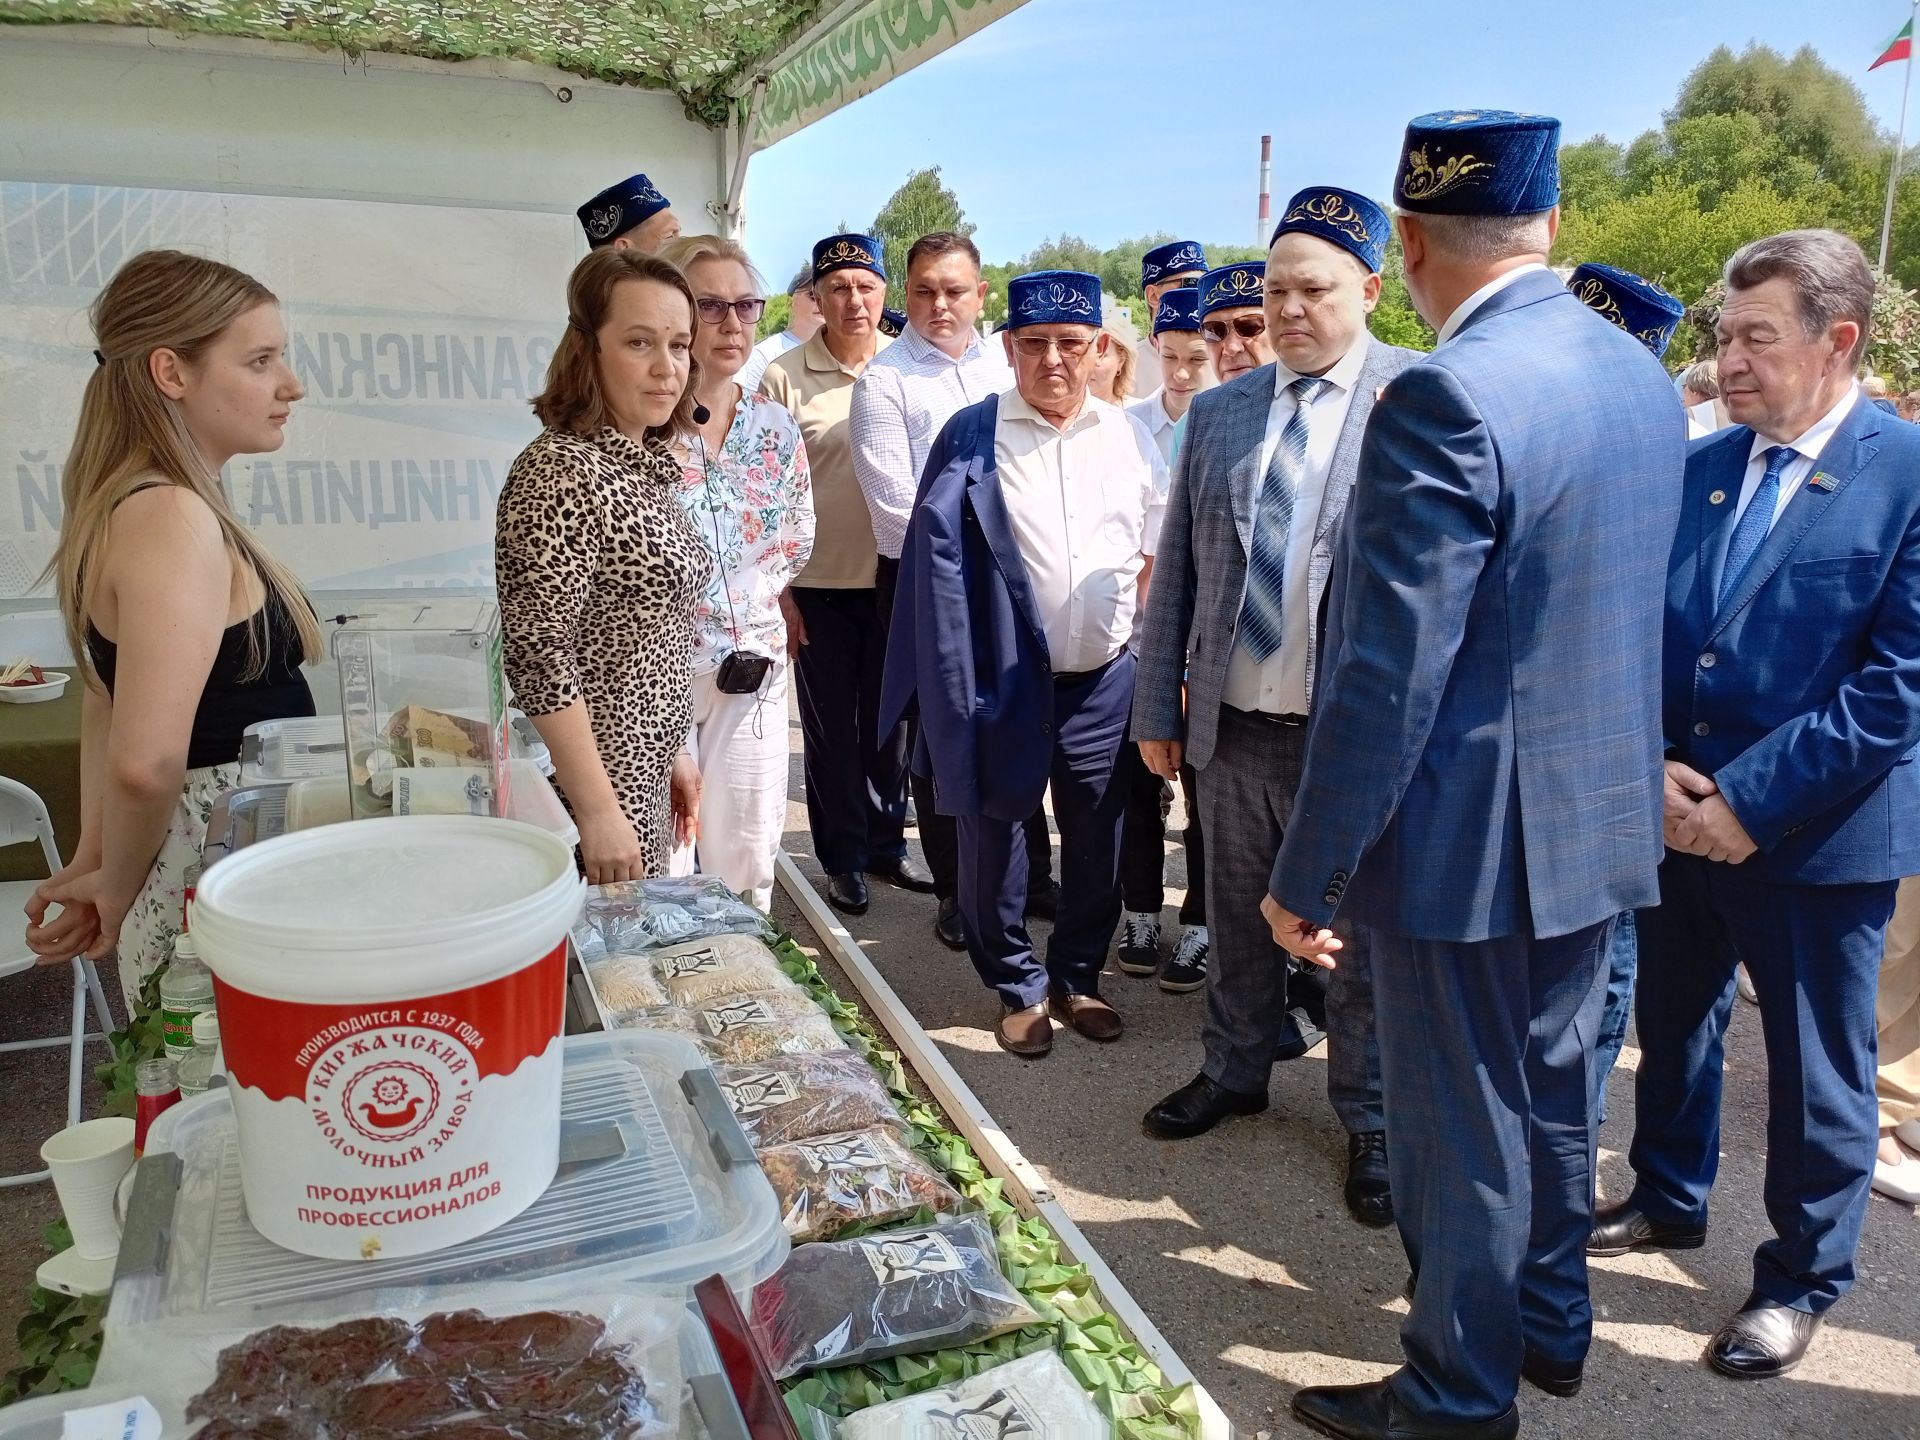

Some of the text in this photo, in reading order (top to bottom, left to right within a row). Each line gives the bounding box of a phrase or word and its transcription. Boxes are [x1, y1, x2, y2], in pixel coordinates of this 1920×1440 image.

[295, 1009, 486, 1068] ПРОИЗВОДИТСЯ С 1937 ГОДА
[313, 1033, 470, 1090] КИРЖАЧСКИЙ
[312, 1089, 473, 1168] МОЛОЧНЫЙ ЗАВОД
[298, 1180, 502, 1227] ПРОФЕССИОНАЛОВ
[306, 1161, 489, 1205] ПРОДУКЦИЯ ДЛЯ
